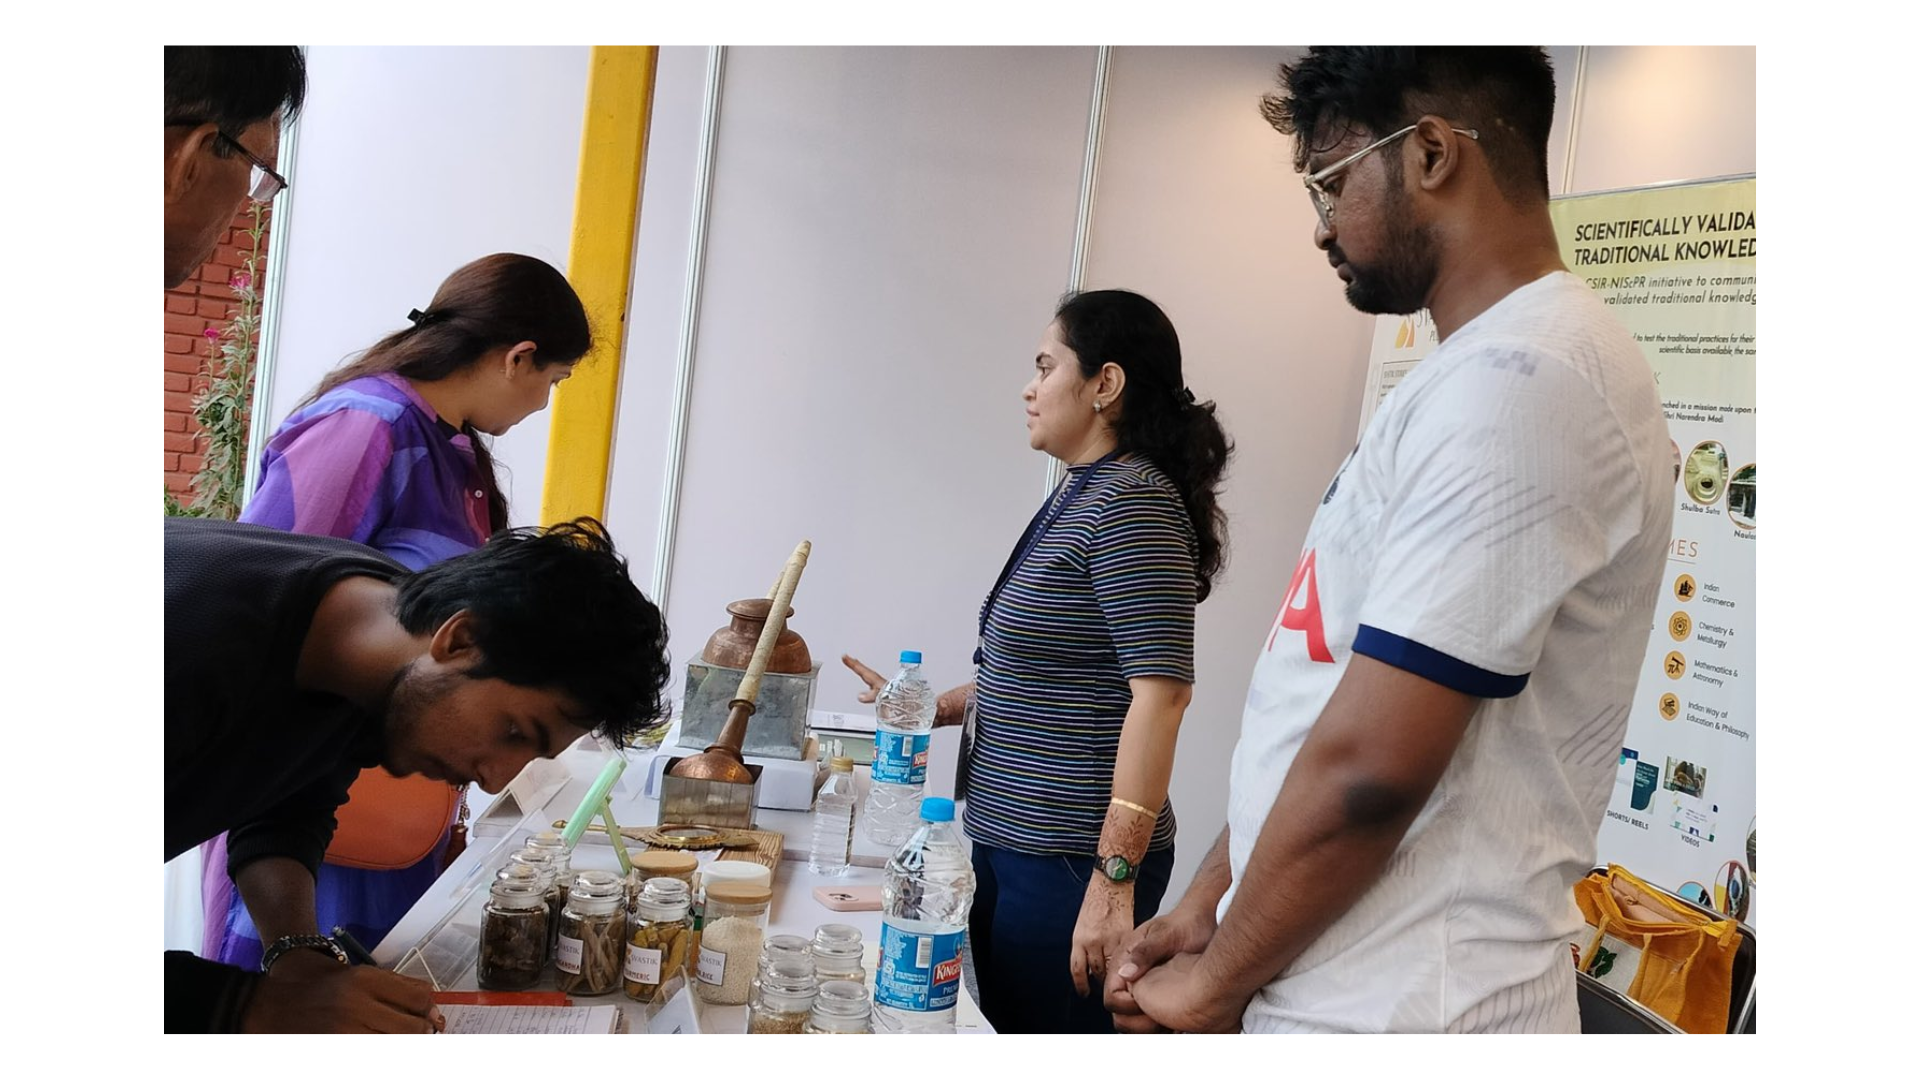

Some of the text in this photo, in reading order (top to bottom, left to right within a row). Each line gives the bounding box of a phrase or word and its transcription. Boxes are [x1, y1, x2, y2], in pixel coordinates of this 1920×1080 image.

[1575, 210, 1756, 242] SCIENTIFICALLY VALIDA
[1574, 237, 1757, 266] TRADITIONAL KNOWLED
[1648, 275, 1693, 288] initiative
[1696, 275, 1707, 287] to
[1603, 292, 1650, 305] validated
[1651, 289, 1707, 304] traditional
[1656, 332, 1666, 342] the
[1667, 332, 1699, 343] traditional
[1699, 334, 1729, 344] practices
[1730, 333, 1739, 343] for
[1740, 333, 1755, 343] their
[1659, 344, 1684, 354] scientific
[1685, 344, 1701, 354] basis
[1734, 345, 1744, 355] the
[1681, 401, 1687, 409] in
[1693, 402, 1718, 411] mission
[1719, 403, 1734, 413] made
[1735, 406, 1752, 417] upon
[1675, 412, 1706, 422] Narendra
[1707, 415, 1724, 423] Modi
[1703, 582, 1720, 593] Indian
[1702, 594, 1736, 609] Commerce
[1699, 621, 1735, 637] Chemistry &
[1697, 633, 1728, 649] Metallurgy
[1694, 659, 1739, 678] Mathematics &
[1692, 672, 1724, 688] Astronomy
[1688, 701, 1729, 719] Indian Way of
[1686, 713, 1750, 741] Education & Philosophy
[1630, 818, 1650, 831] REELS
[1681, 834, 1701, 848] VIDEOS
